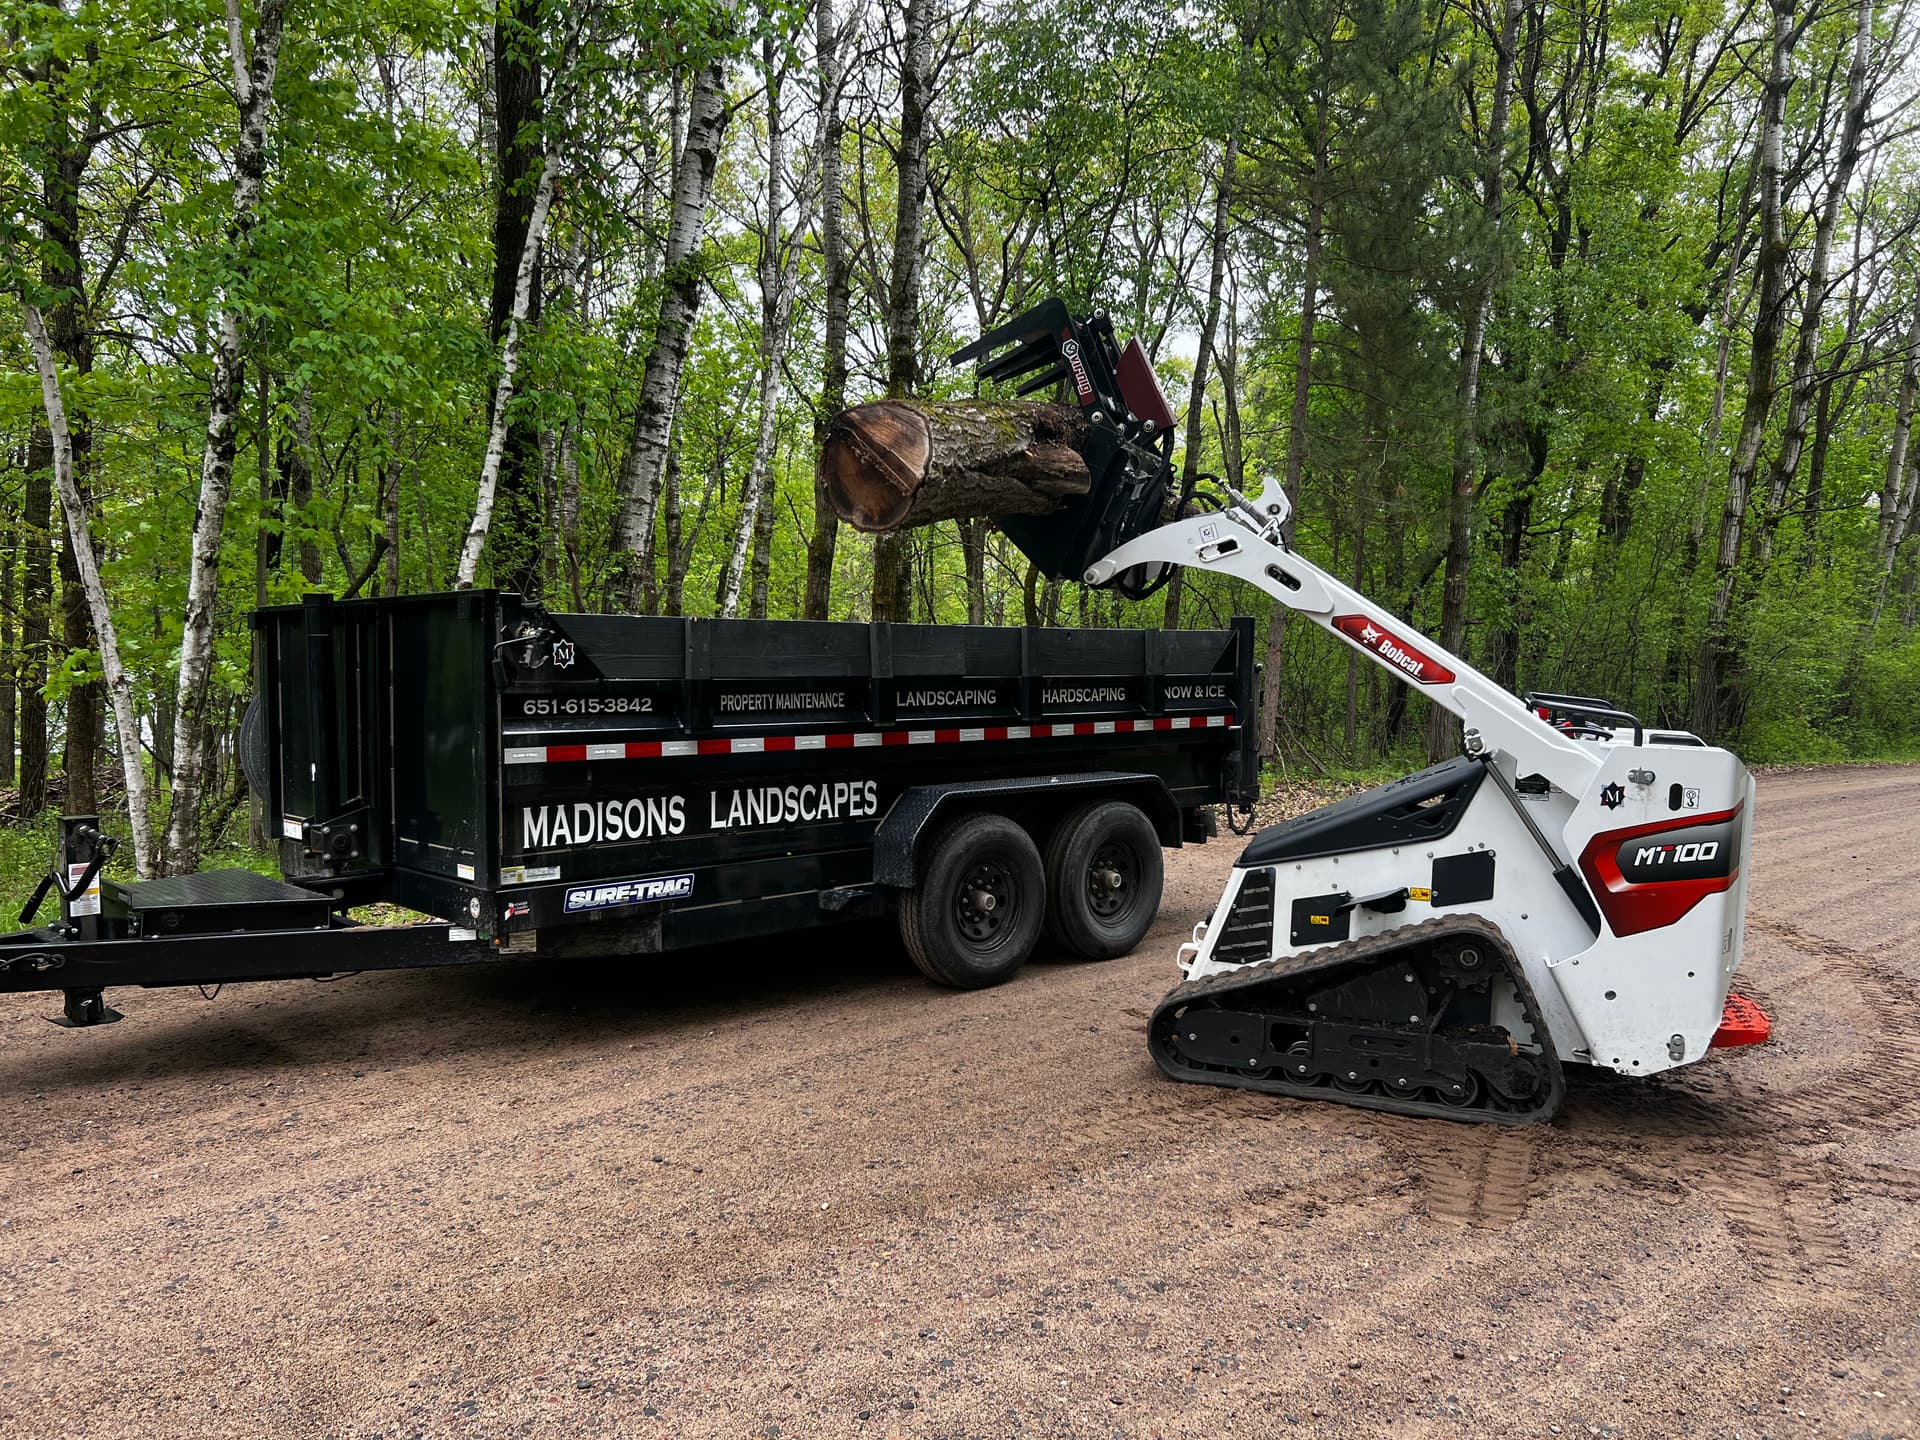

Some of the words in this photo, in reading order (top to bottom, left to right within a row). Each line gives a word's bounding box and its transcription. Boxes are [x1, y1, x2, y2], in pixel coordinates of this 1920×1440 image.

[559, 648, 569, 660] M
[1378, 639, 1424, 676] Bobcat
[896, 690, 997, 707] LANDSCAPING
[1042, 687, 1126, 704] HARDSCAPING
[1164, 685, 1192, 699] NOW
[1194, 685, 1204, 698] &
[1205, 684, 1226, 698] ICE
[523, 697, 653, 715] 651-615-3842
[720, 694, 774, 711] PROPERTY
[775, 693, 845, 709] MAINTENANCE
[1606, 790, 1620, 803] M
[523, 795, 686, 849] MADISONS
[711, 780, 878, 829] LANDSCAPES
[1633, 841, 1719, 866] MT100
[568, 877, 691, 909] SURE-TRAC
